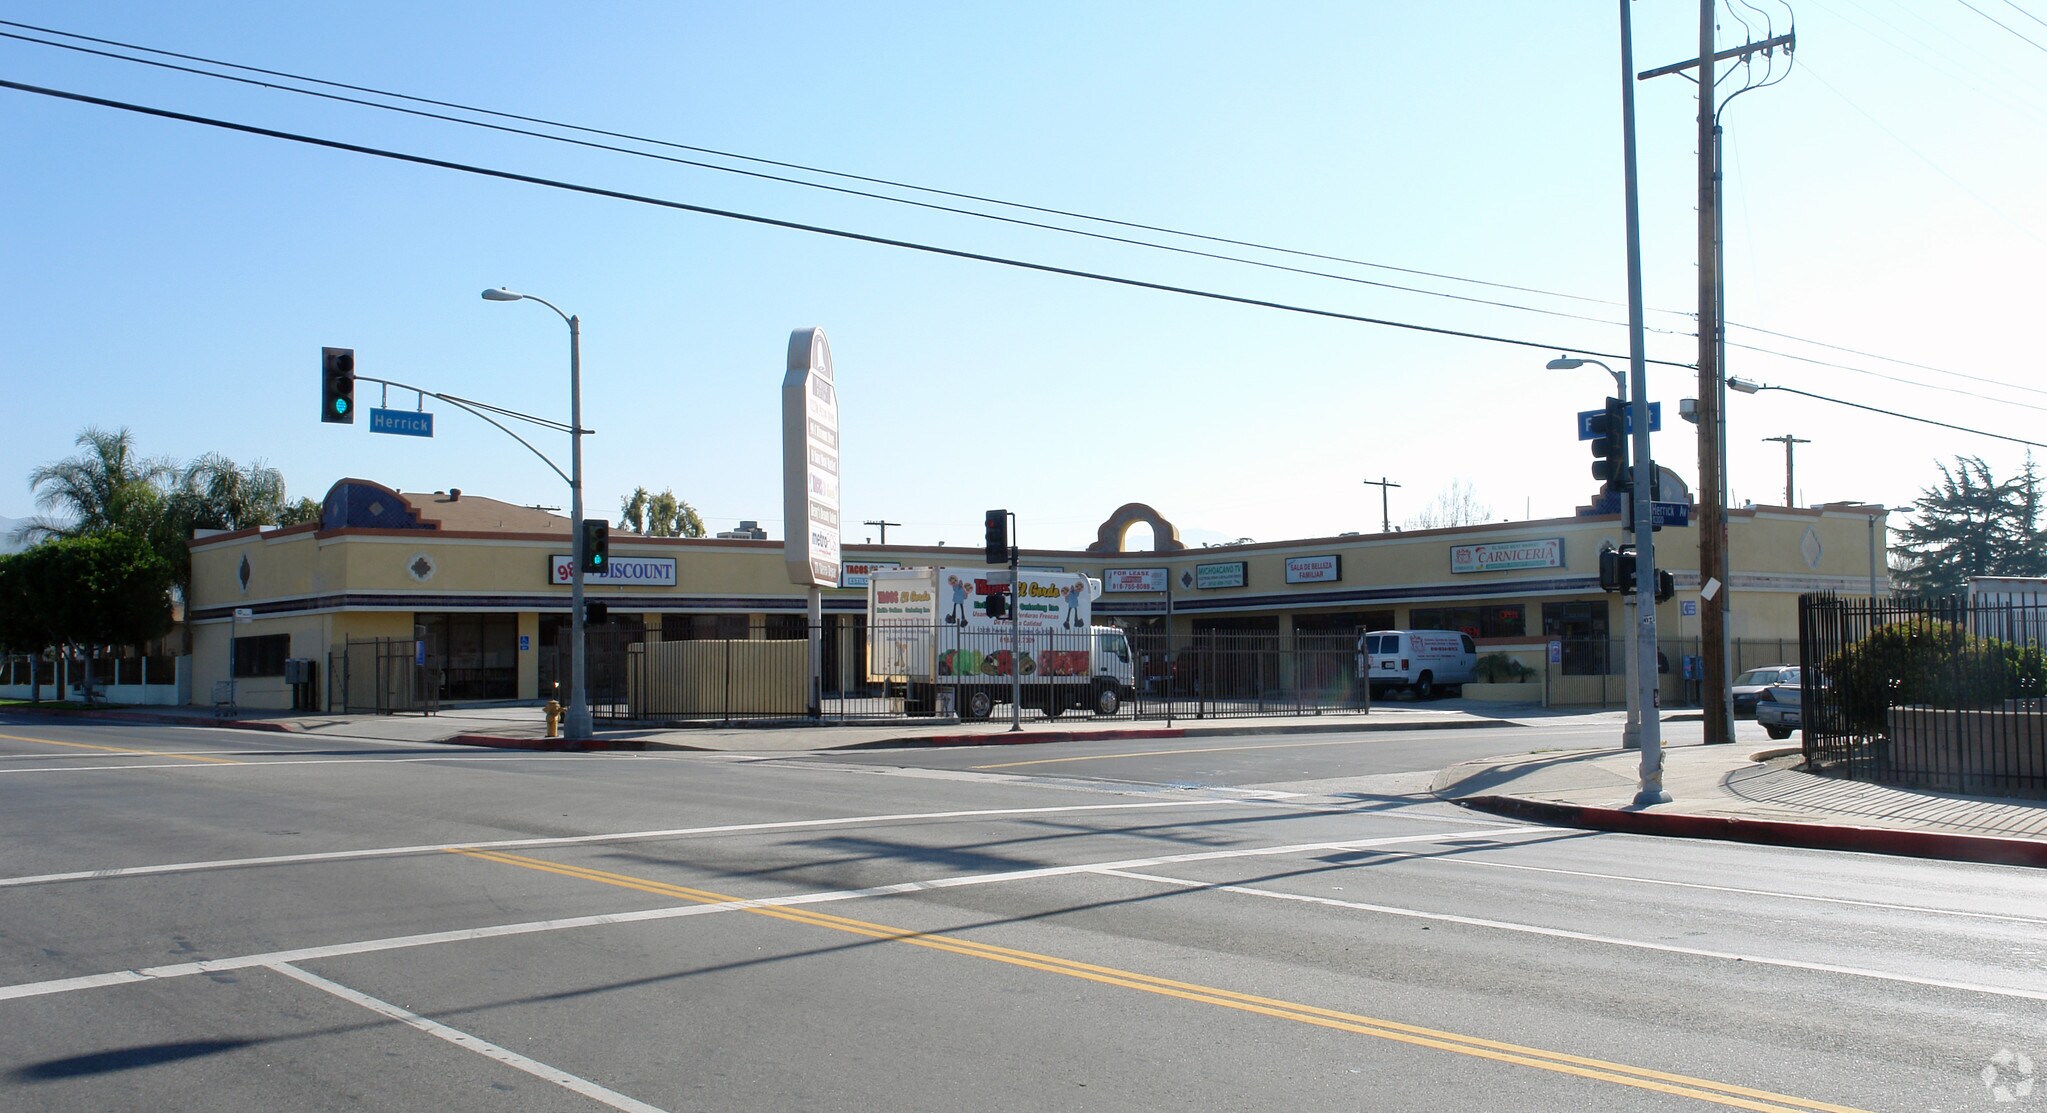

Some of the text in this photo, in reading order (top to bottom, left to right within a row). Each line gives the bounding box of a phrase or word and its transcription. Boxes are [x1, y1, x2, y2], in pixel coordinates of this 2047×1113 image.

[374, 414, 428, 432] Herrick
[1651, 503, 1675, 517] Herrick
[1478, 547, 1554, 563] CARNICERIA
[845, 564, 868, 575] TACOS
[1304, 562, 1311, 570] DE
[1299, 570, 1324, 579] FAMILIAR
[1028, 582, 1060, 598] Gordo
